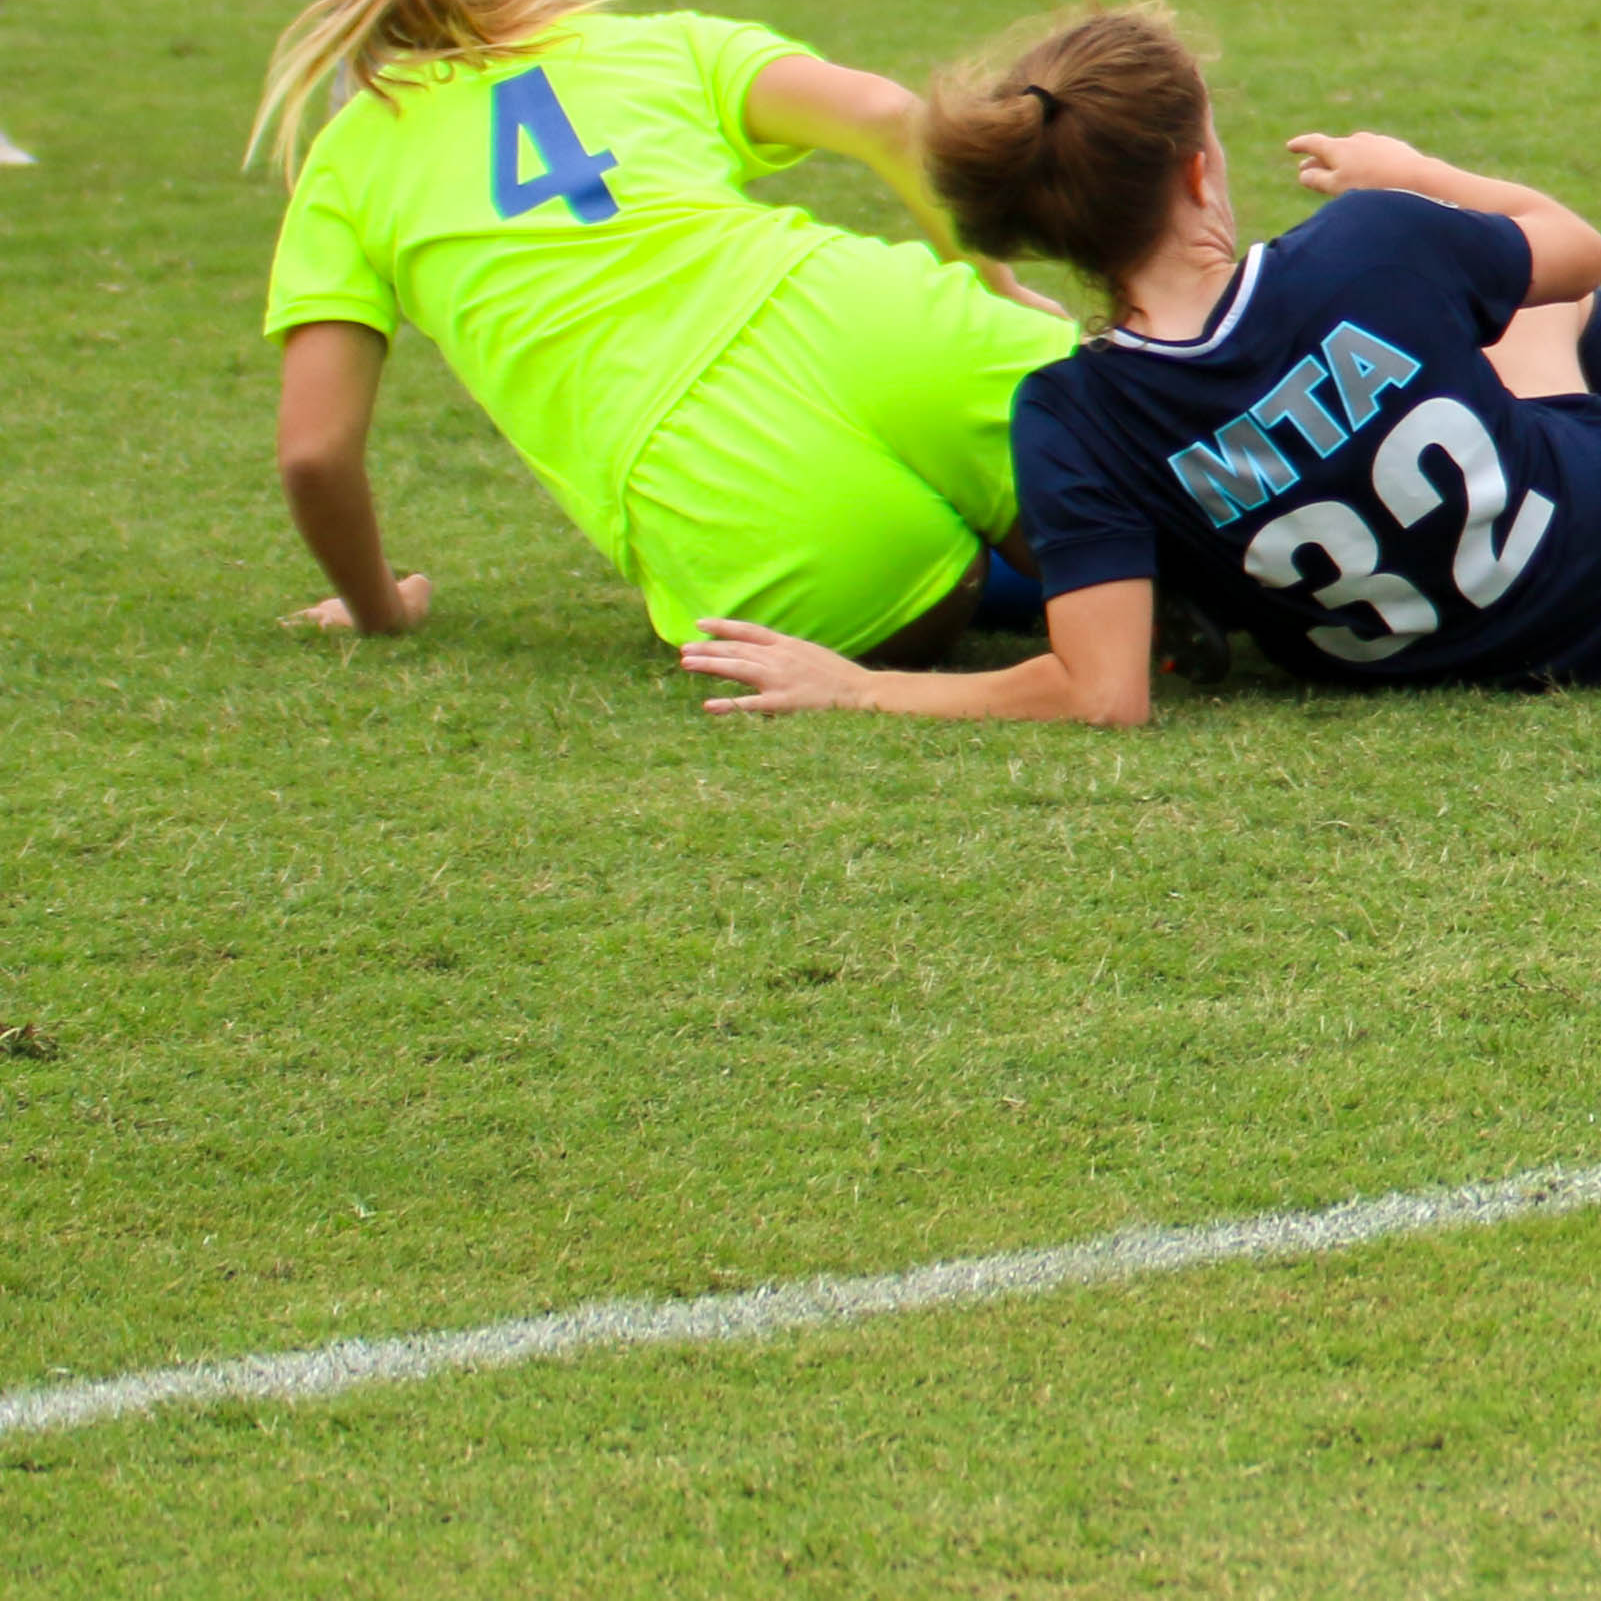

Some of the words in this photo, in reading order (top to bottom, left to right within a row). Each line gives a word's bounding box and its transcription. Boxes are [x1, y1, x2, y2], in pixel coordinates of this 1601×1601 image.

[490, 65, 620, 225] 4
[1167, 320, 1422, 529] MTA
[1244, 397, 1555, 663] 32
